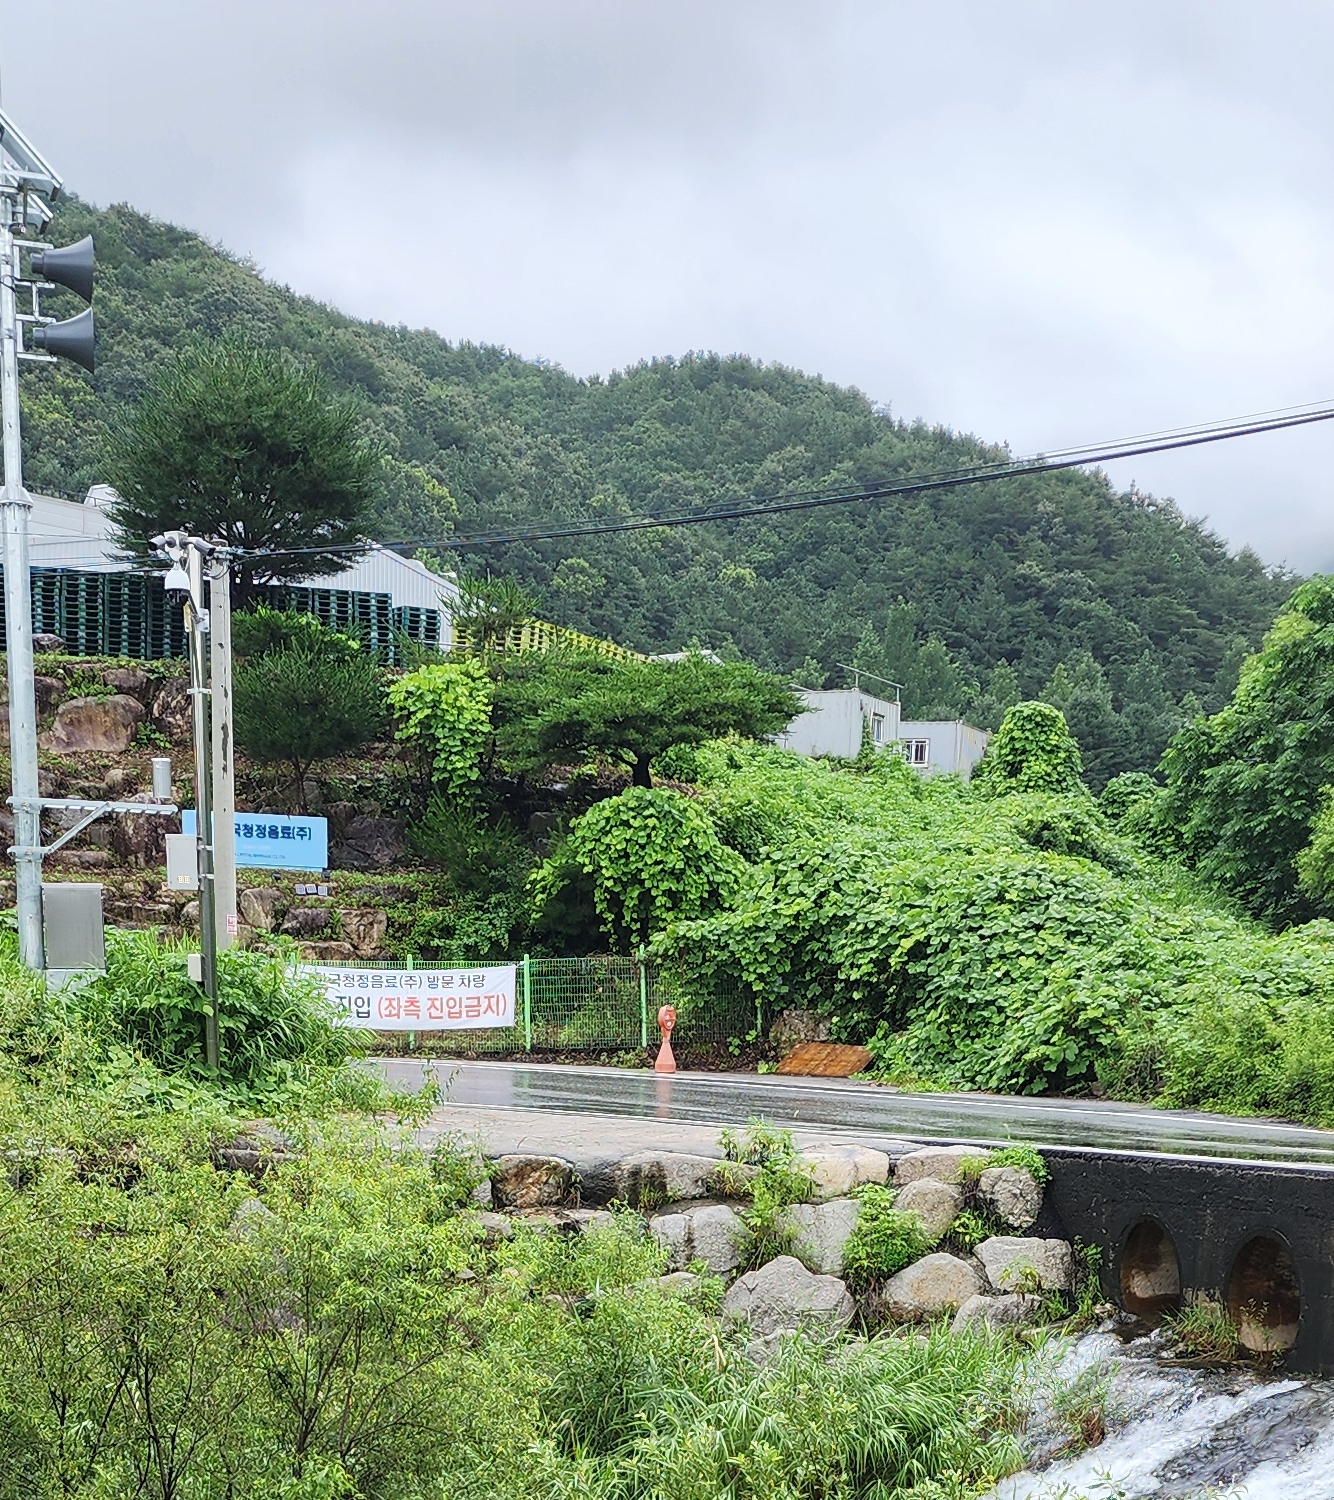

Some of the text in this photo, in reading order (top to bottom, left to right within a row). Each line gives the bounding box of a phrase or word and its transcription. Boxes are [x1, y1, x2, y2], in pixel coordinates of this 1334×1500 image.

[427, 975, 454, 989] 방문
[458, 973, 486, 988] 차량
[378, 996, 421, 1019] (좌측
[426, 993, 507, 1019] 진입금지)
